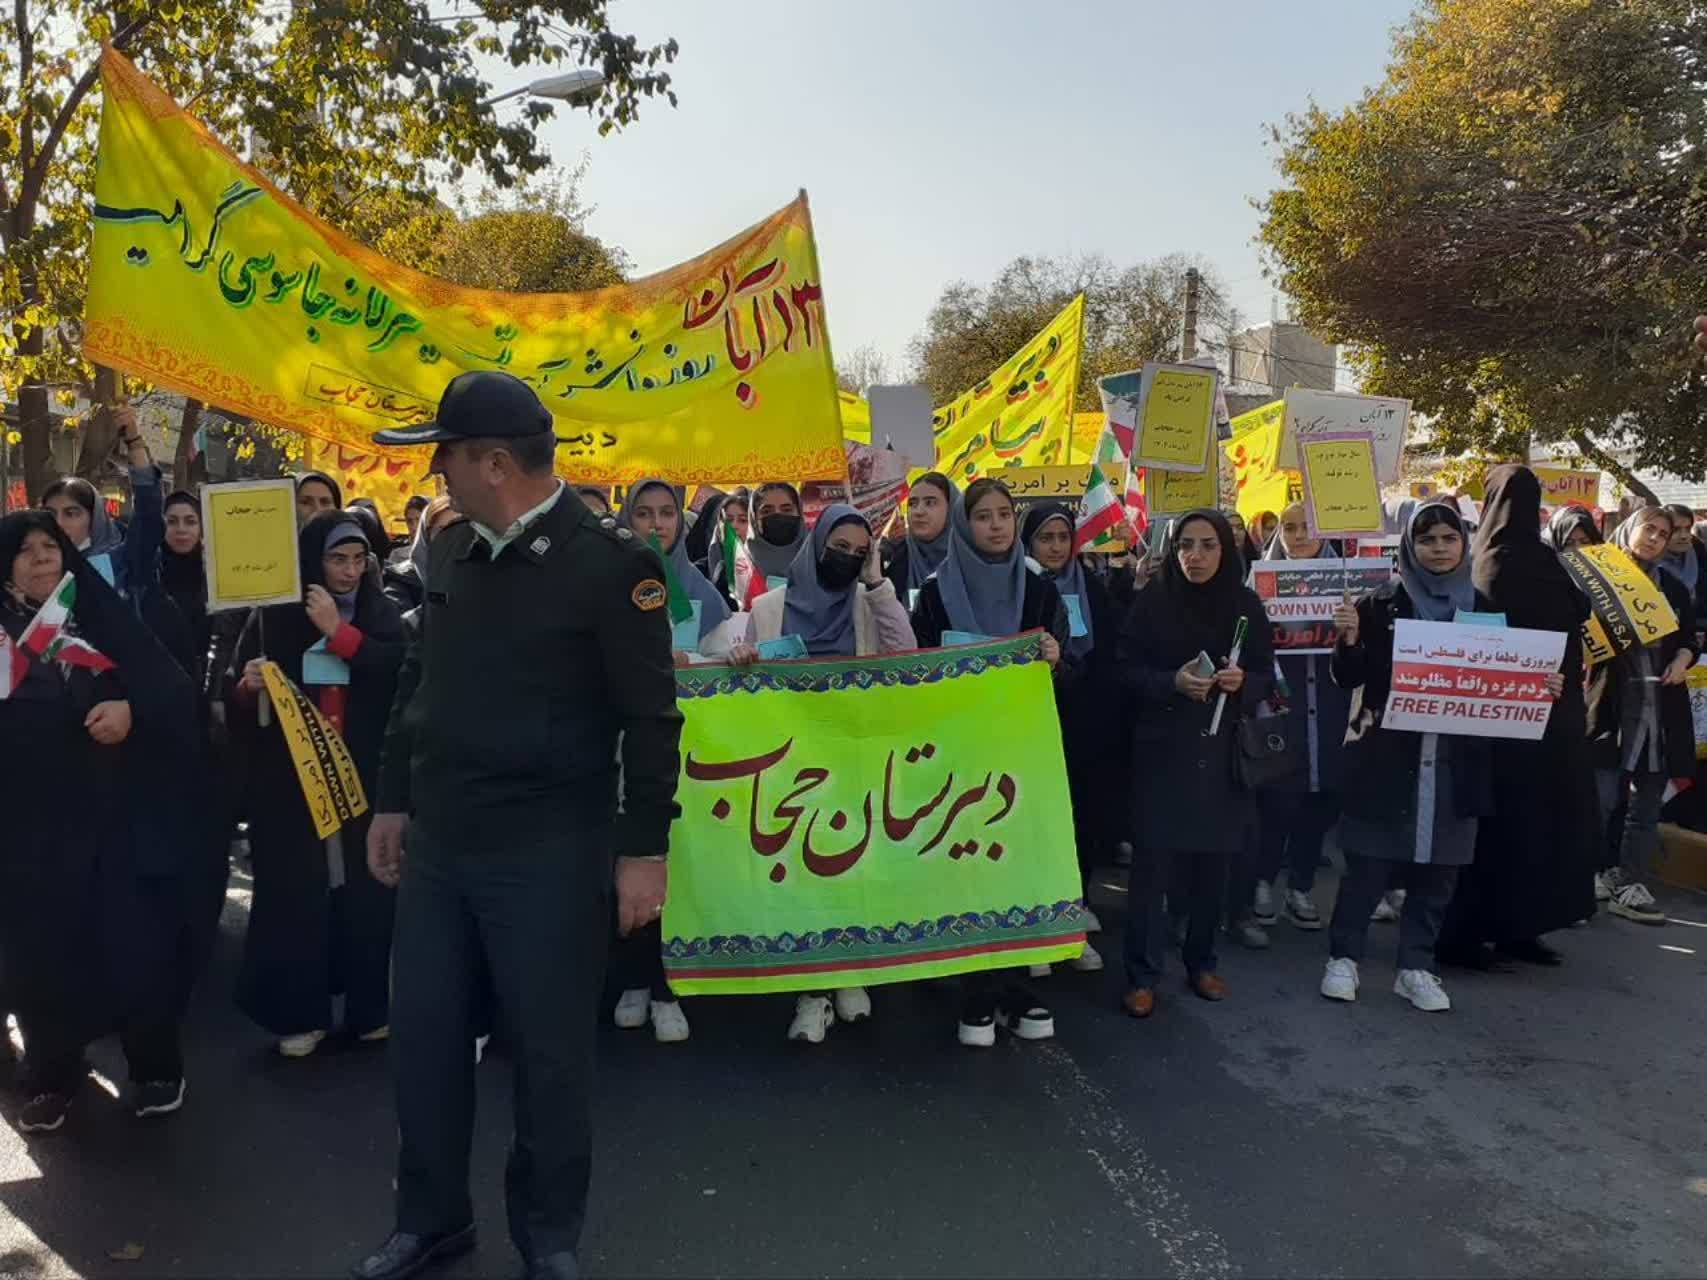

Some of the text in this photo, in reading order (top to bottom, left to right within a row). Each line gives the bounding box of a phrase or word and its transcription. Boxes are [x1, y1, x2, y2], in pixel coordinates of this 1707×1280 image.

[682, 257, 784, 406] آبان
[1054, 477, 1069, 493] بر
[1587, 576, 1612, 609] WITH
[1266, 602, 1308, 617] OWN
[1390, 696, 1547, 723] FREE PALESTINE
[685, 735, 1017, 884] دبیرستان حجاب
